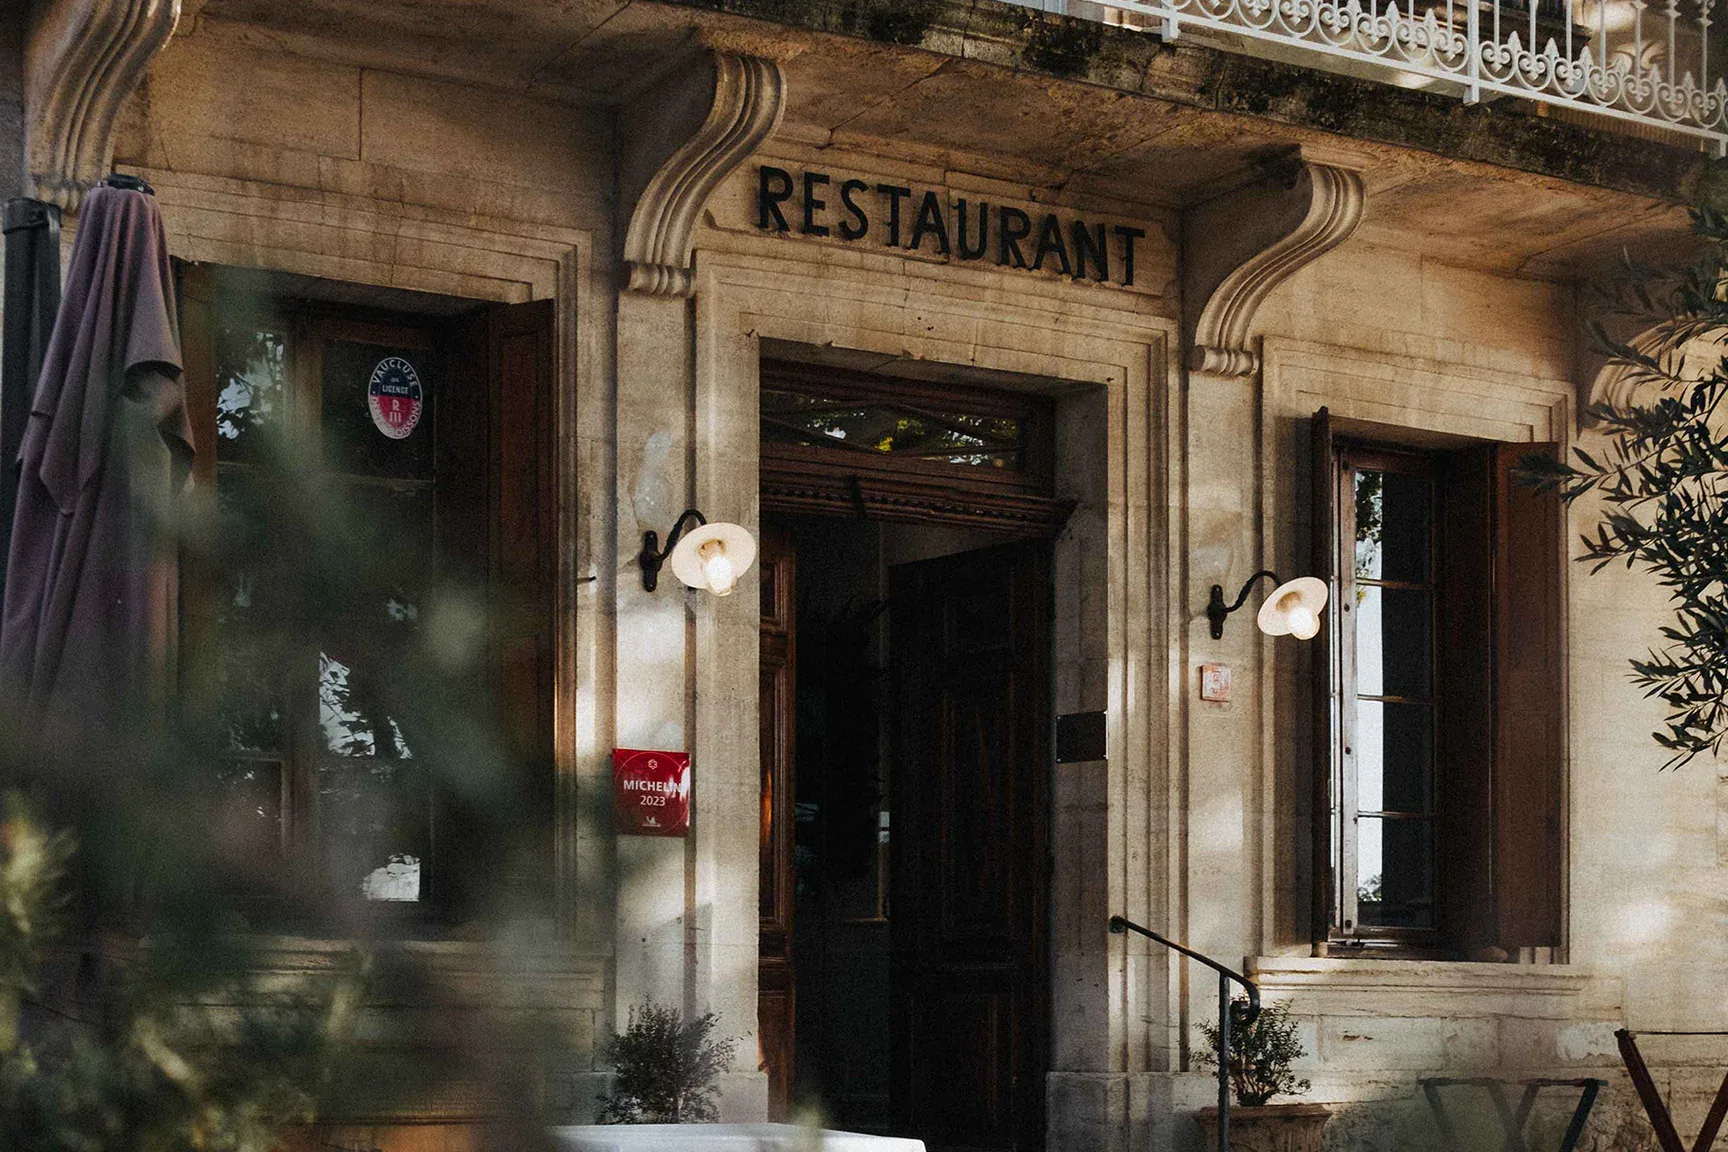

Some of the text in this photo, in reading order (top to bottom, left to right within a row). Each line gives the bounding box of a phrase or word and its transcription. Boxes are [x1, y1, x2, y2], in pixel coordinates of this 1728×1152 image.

[758, 164, 1146, 287] RESTAURANT
[372, 359, 418, 387] VAUCLUSE
[382, 385, 409, 395] LICENCE
[390, 400, 421, 437] OISSONS
[623, 779, 682, 793] MICHELIN
[640, 795, 666, 806] 2023
